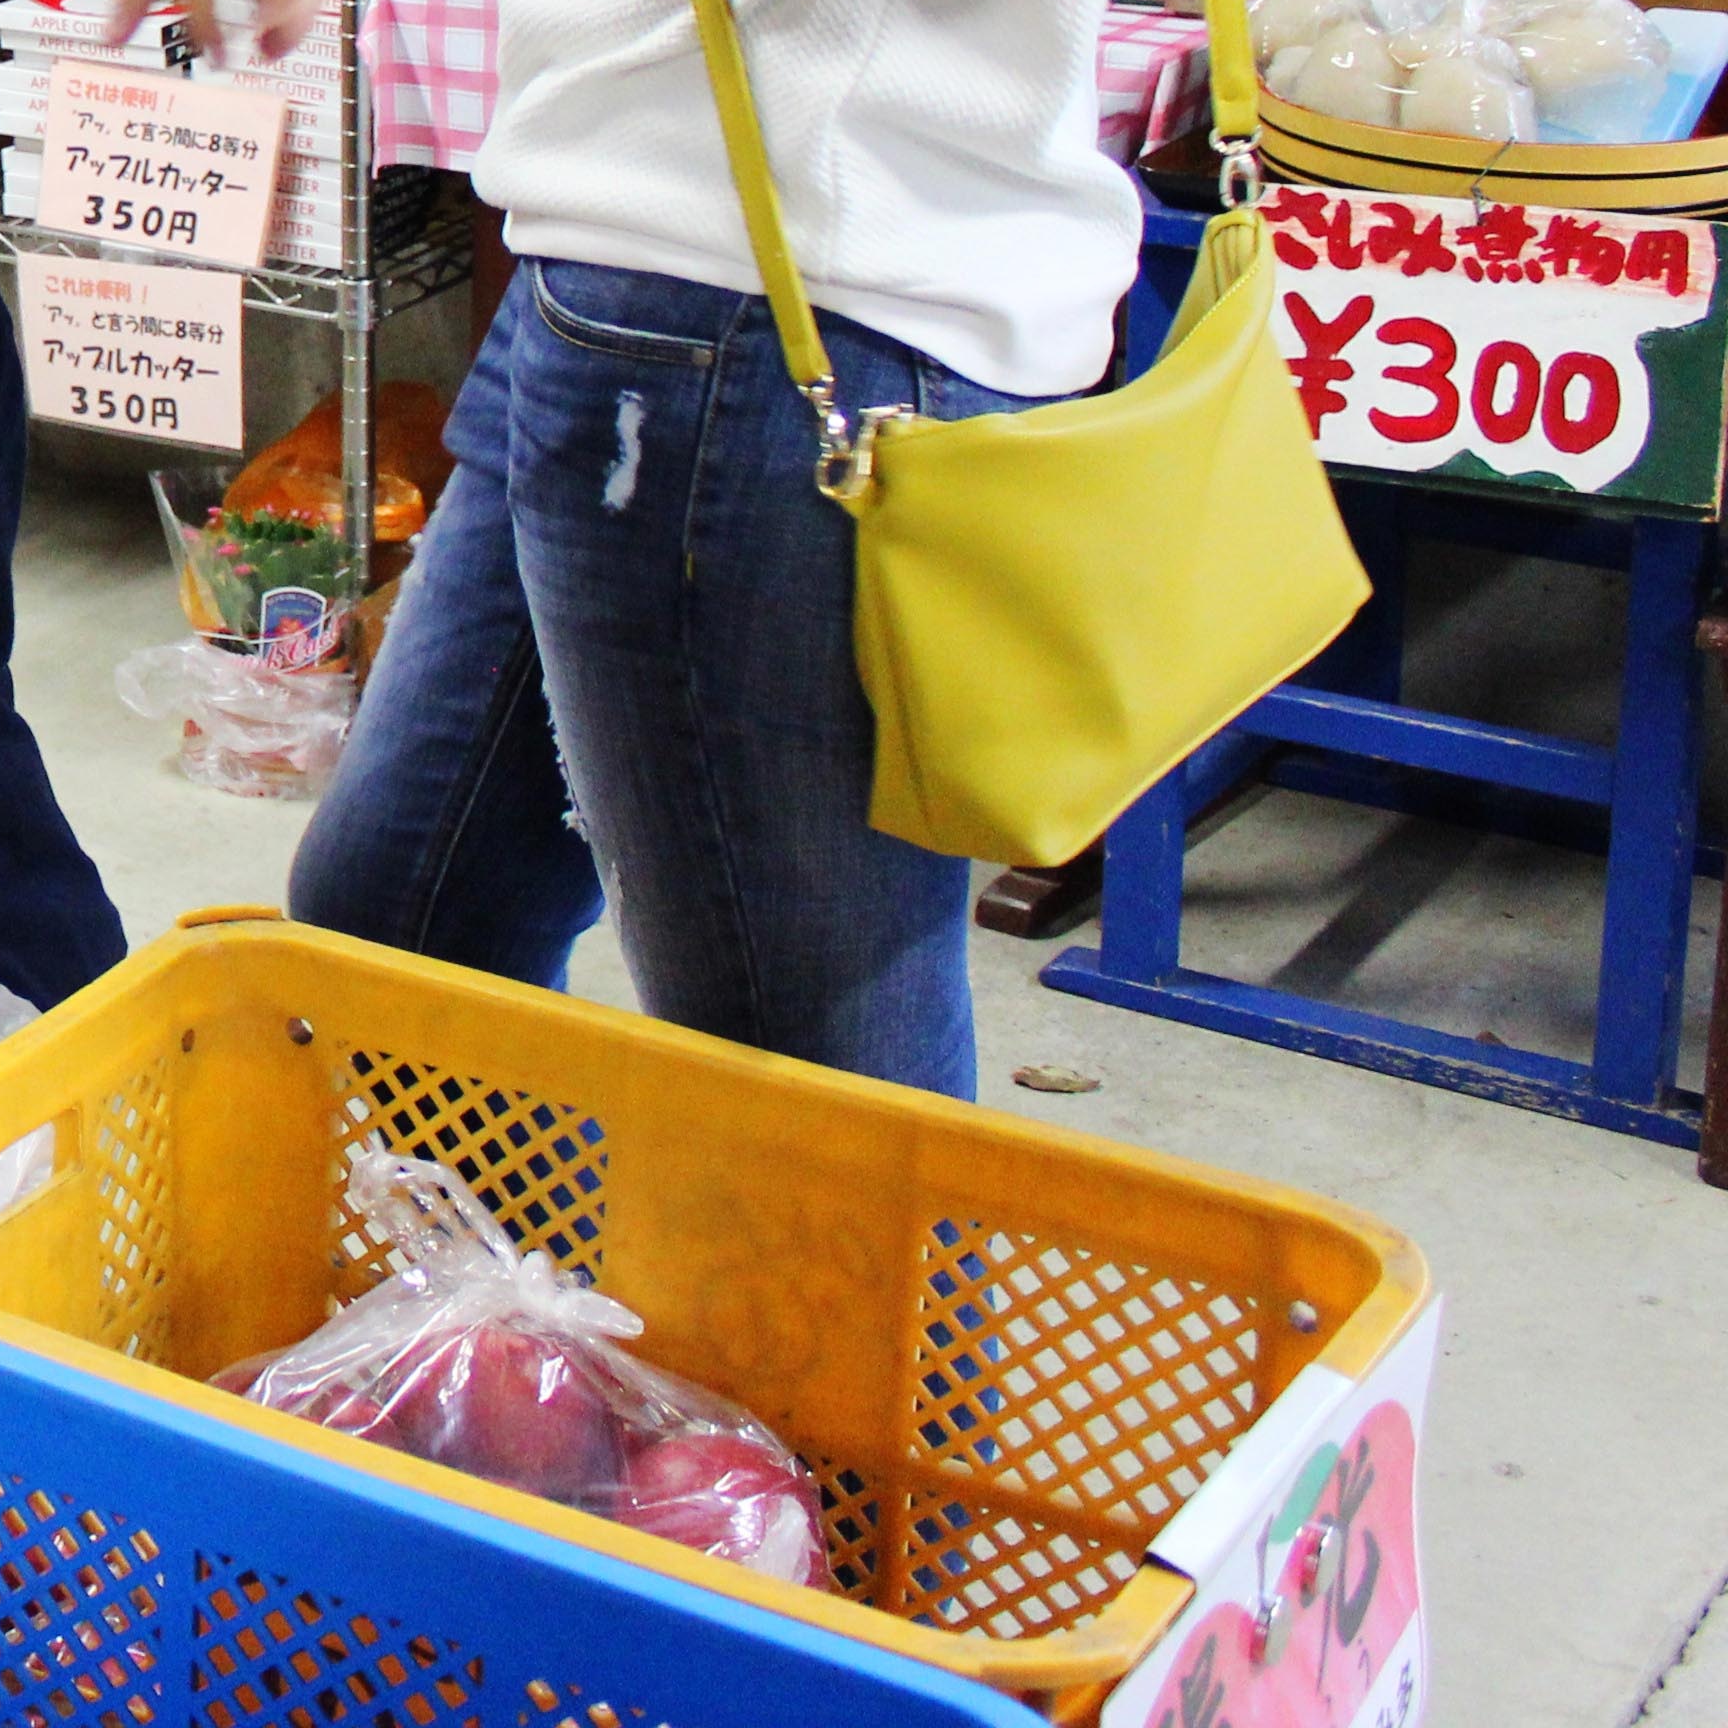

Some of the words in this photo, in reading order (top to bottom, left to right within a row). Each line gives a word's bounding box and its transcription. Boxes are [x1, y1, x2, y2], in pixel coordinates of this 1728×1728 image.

[32, 15, 69, 32] APPLE
[39, 36, 75, 54] APPLE
[77, 40, 126, 61] CUTTER
[277, 80, 327, 102] CUTTER
[65, 145, 249, 197] アップルカッター
[83, 194, 199, 245] 350円
[1264, 186, 1691, 296] さしみ煮物用
[42, 338, 220, 381] アップルカッター
[1282, 290, 1622, 455] ¥300
[69, 385, 179, 431] 350円
